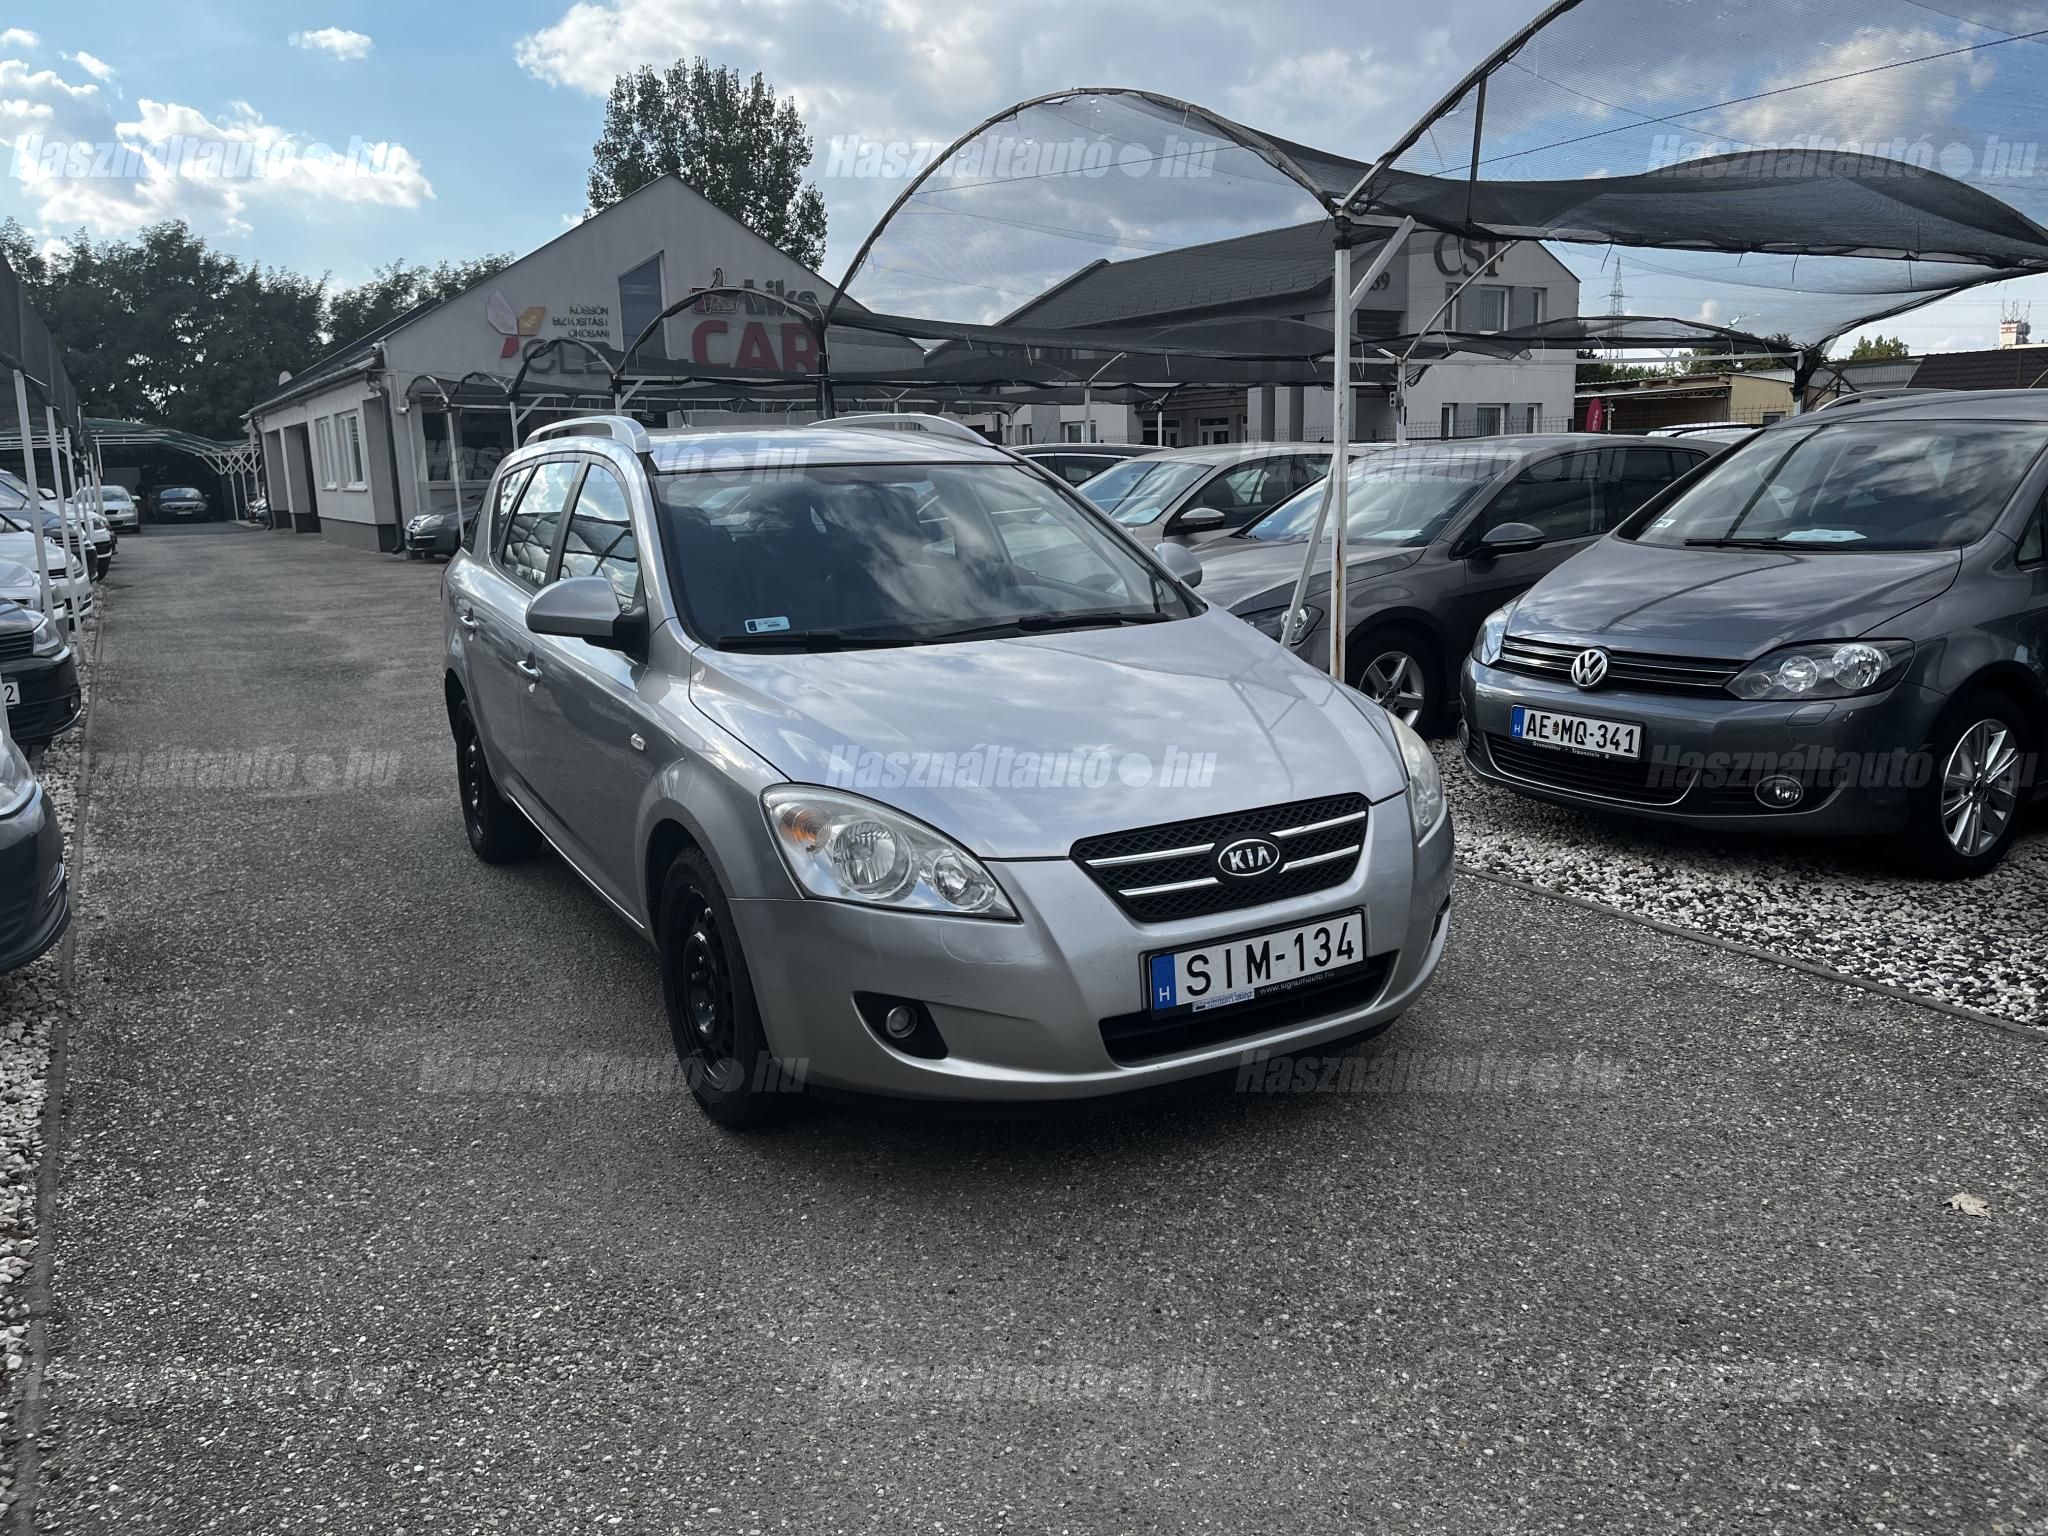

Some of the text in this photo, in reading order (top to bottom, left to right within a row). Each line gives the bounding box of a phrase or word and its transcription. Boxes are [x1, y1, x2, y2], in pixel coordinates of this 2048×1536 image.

[692, 319, 819, 374] CAR
[1228, 846, 1272, 871] KIA
[1159, 922, 1354, 1003] H SIM-134
